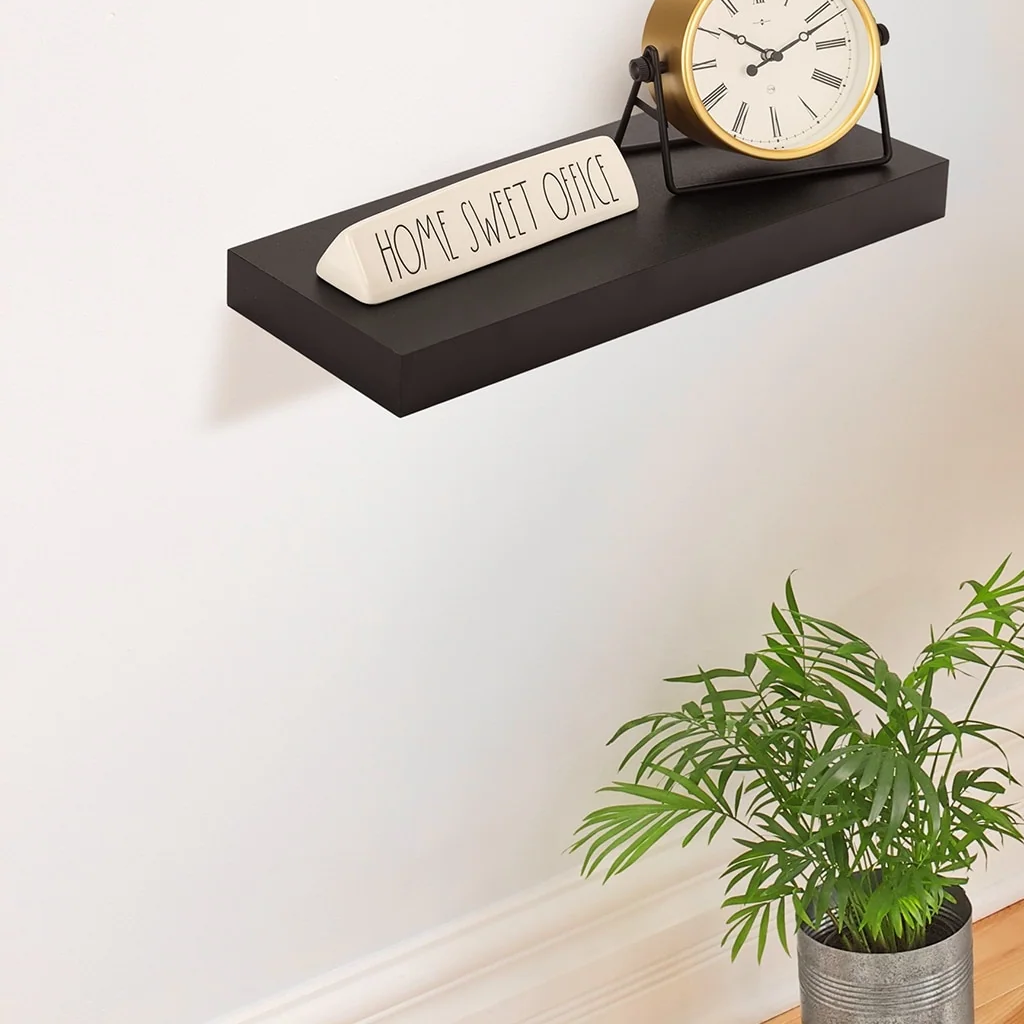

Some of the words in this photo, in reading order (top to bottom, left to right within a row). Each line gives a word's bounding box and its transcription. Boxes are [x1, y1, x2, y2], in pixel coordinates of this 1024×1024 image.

[804, 0, 831, 23] II
[815, 37, 847, 51] III
[811, 68, 843, 90] IIII
[375, 210, 459, 282] HOME
[460, 180, 538, 253] SWEET
[542, 154, 620, 221] OFFICE
